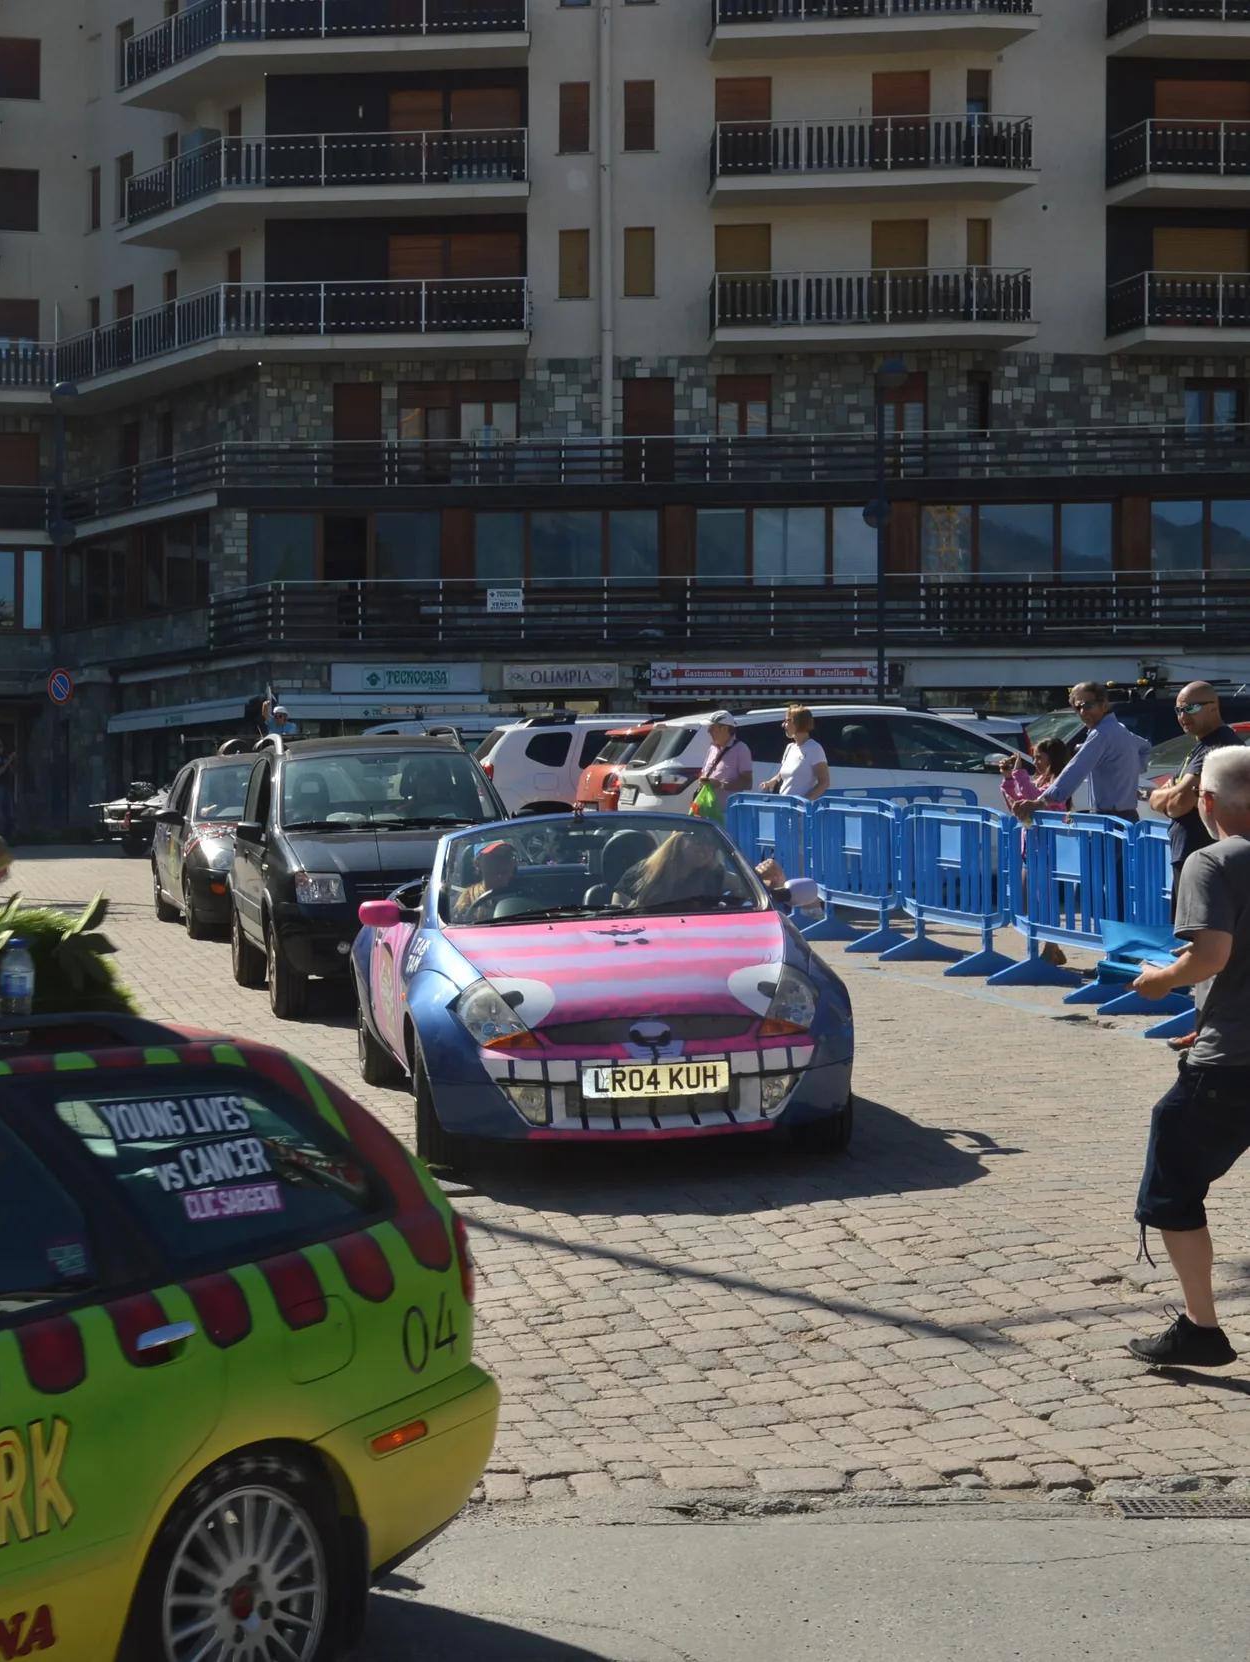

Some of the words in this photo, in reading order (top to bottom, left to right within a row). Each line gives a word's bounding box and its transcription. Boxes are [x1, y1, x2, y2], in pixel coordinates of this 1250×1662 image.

[386, 670, 448, 685] TECNOCASA
[531, 670, 591, 684] OLIMPIA
[685, 669, 732, 677] Gastronomia
[743, 668, 804, 677] NONSOLOCARNI
[814, 668, 855, 677] Macelleria
[594, 1068, 660, 1093] LR04
[669, 1065, 717, 1090] KUH
[101, 1100, 187, 1141] YOUNG
[180, 1096, 251, 1134] LIVES
[180, 1137, 272, 1186] CANCER
[184, 1192, 218, 1220] CLIC
[217, 1185, 282, 1214] SARGENT
[402, 1290, 458, 1375] 04
